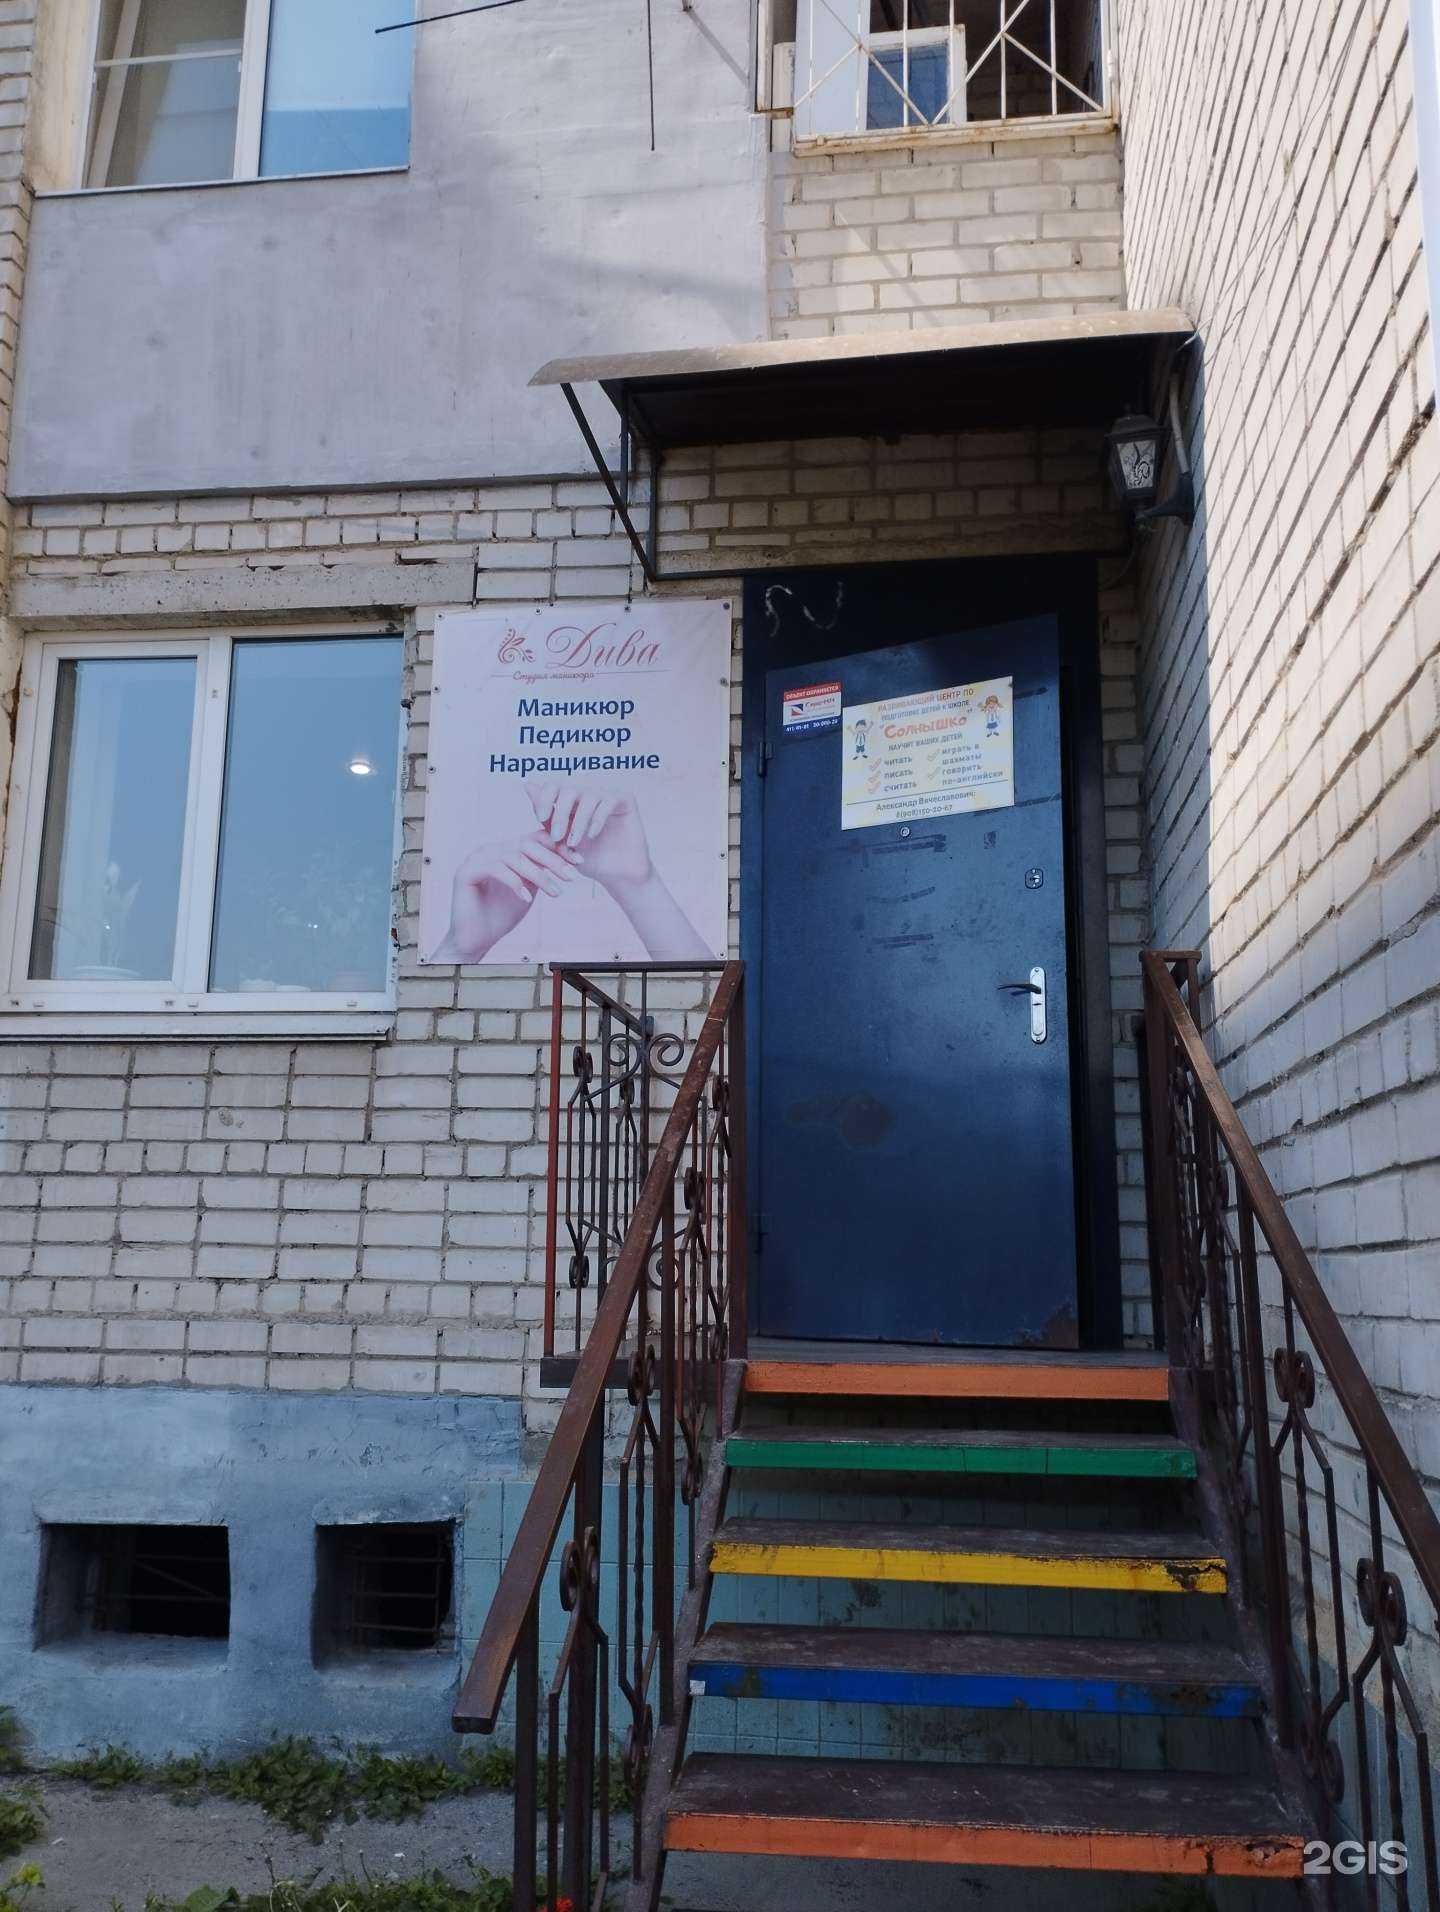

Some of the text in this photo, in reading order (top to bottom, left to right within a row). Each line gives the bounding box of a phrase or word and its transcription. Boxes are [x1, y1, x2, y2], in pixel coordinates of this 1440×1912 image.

[545, 622, 662, 669] Дива
[937, 690, 960, 702] ЦЕНТР
[963, 688, 974, 697] ПО
[517, 698, 635, 720] Маникюр
[921, 704, 941, 714] ДЕТЕЙ
[519, 726, 632, 748] Педикюр
[888, 732, 963, 751] НАУЧИТ ВАШИХ ДЕТЕЙ
[942, 744, 972, 755] играть
[489, 753, 660, 777] Наращивание
[884, 756, 912, 766] читать
[942, 754, 982, 765] шахматы
[884, 769, 913, 779] писать
[942, 764, 981, 776] говорить
[942, 770, 1003, 786] по-английски
[883, 782, 917, 792] считать
[876, 800, 918, 812] Александр
